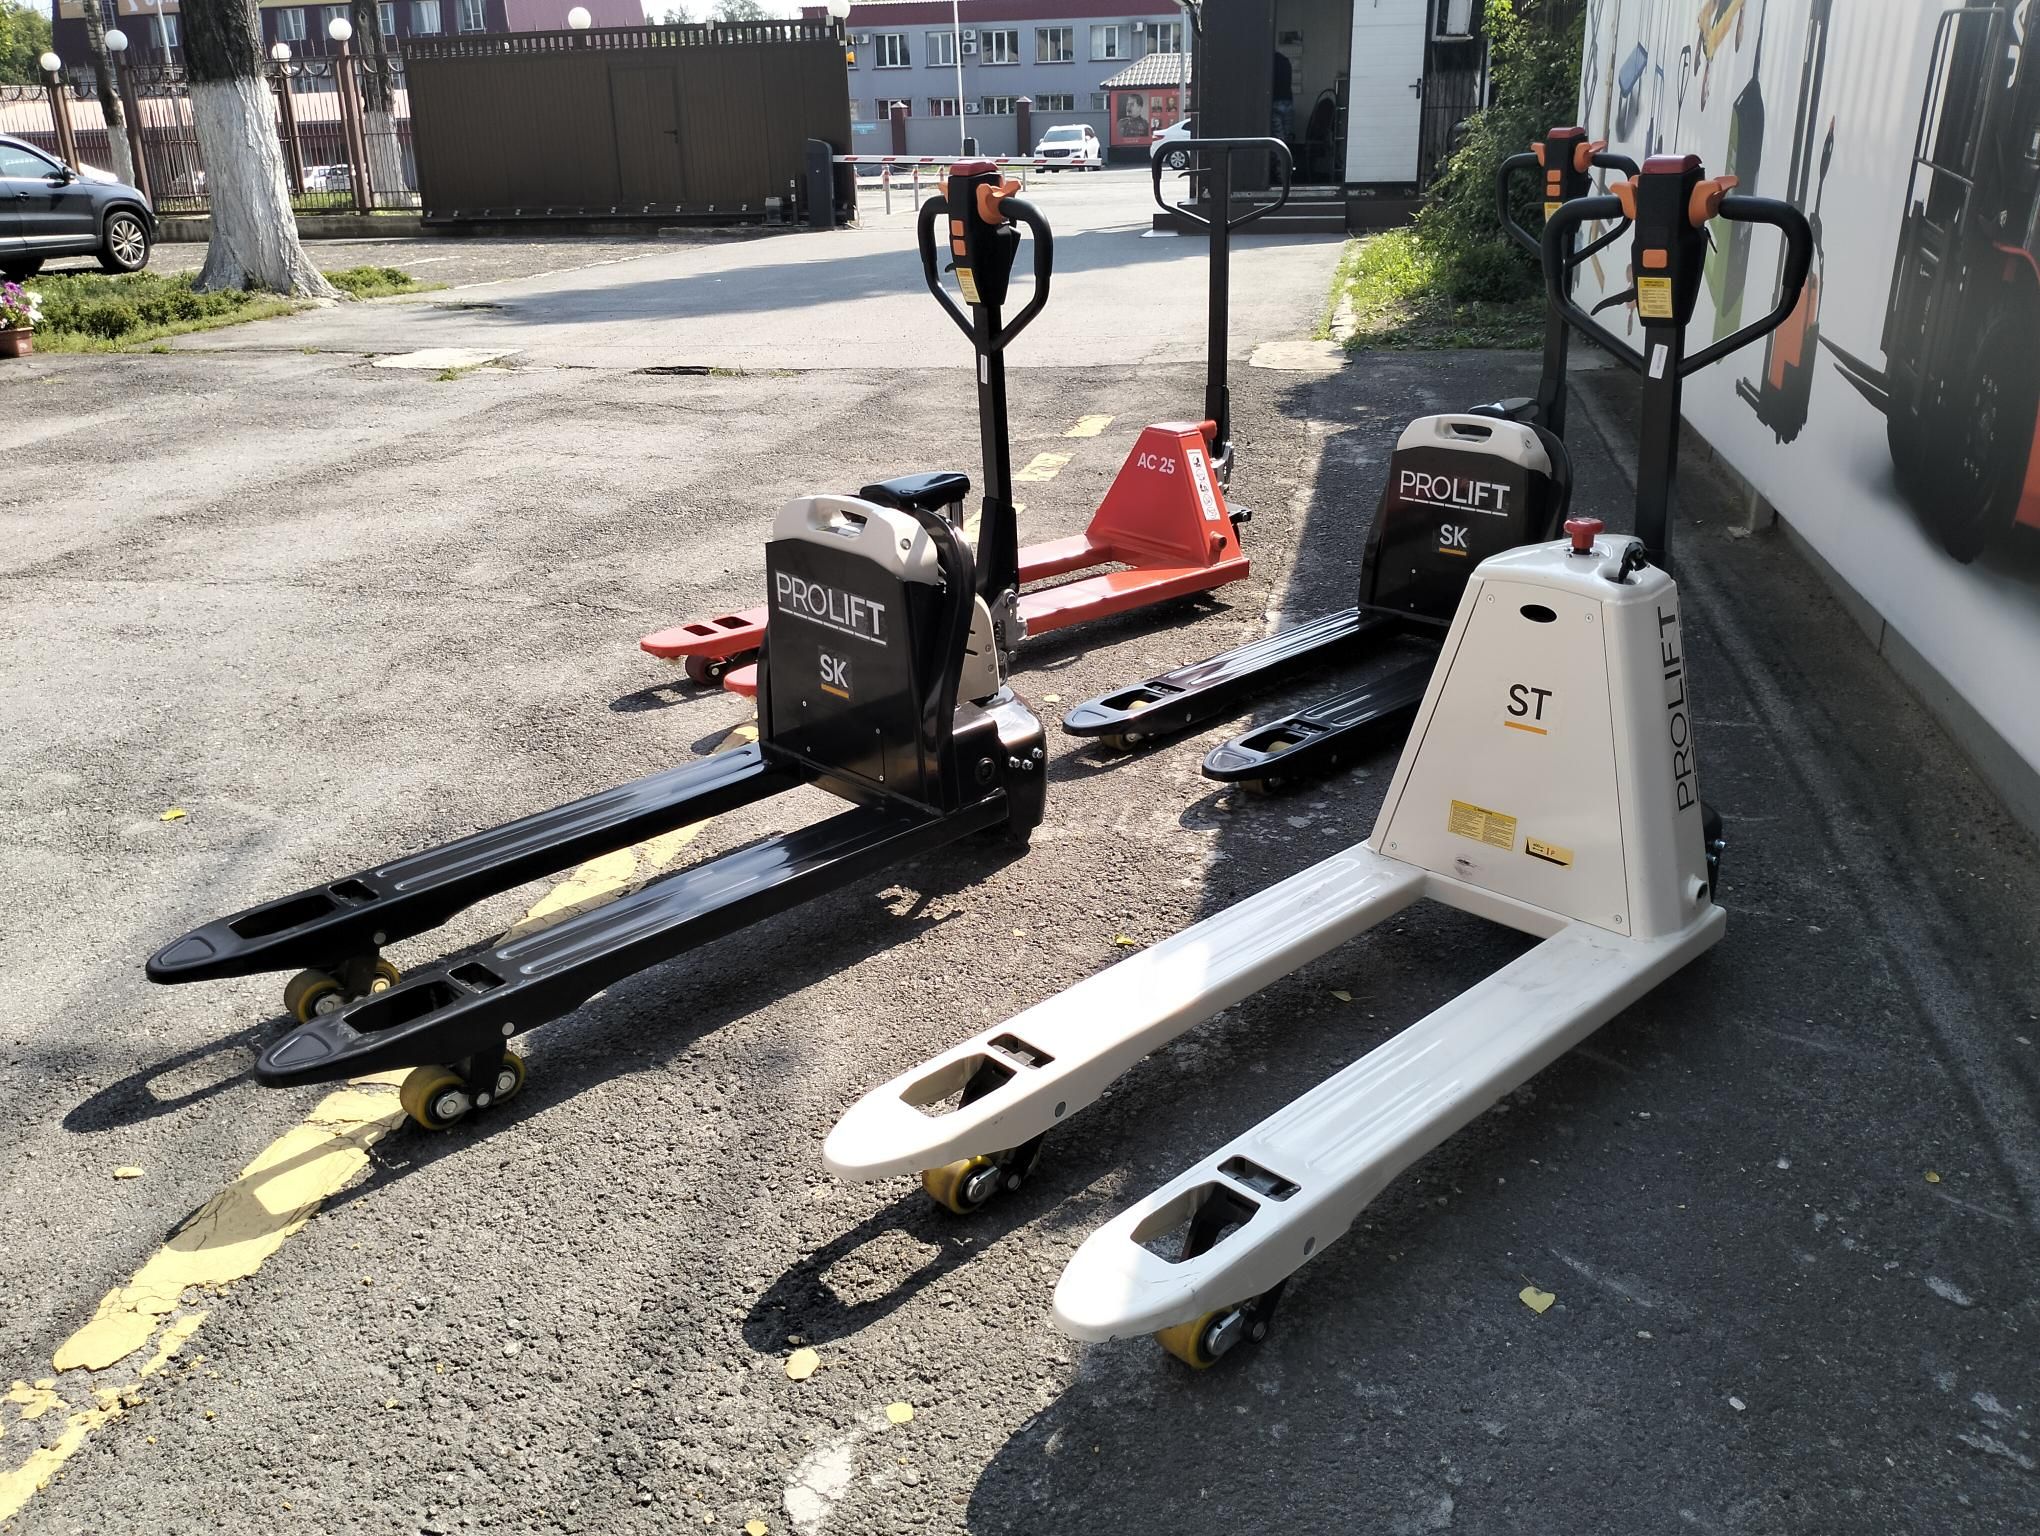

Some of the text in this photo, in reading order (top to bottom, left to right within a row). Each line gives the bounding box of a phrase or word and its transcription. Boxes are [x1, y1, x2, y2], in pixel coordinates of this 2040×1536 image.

[1137, 452, 1176, 475] AC 25
[1399, 469, 1511, 510] PROLIFT
[1439, 523, 1469, 548] SK
[775, 571, 886, 635] PROLIFT
[819, 653, 849, 688] SK
[1506, 683, 1553, 721] ST
[1657, 605, 1695, 812] PROLIFT
